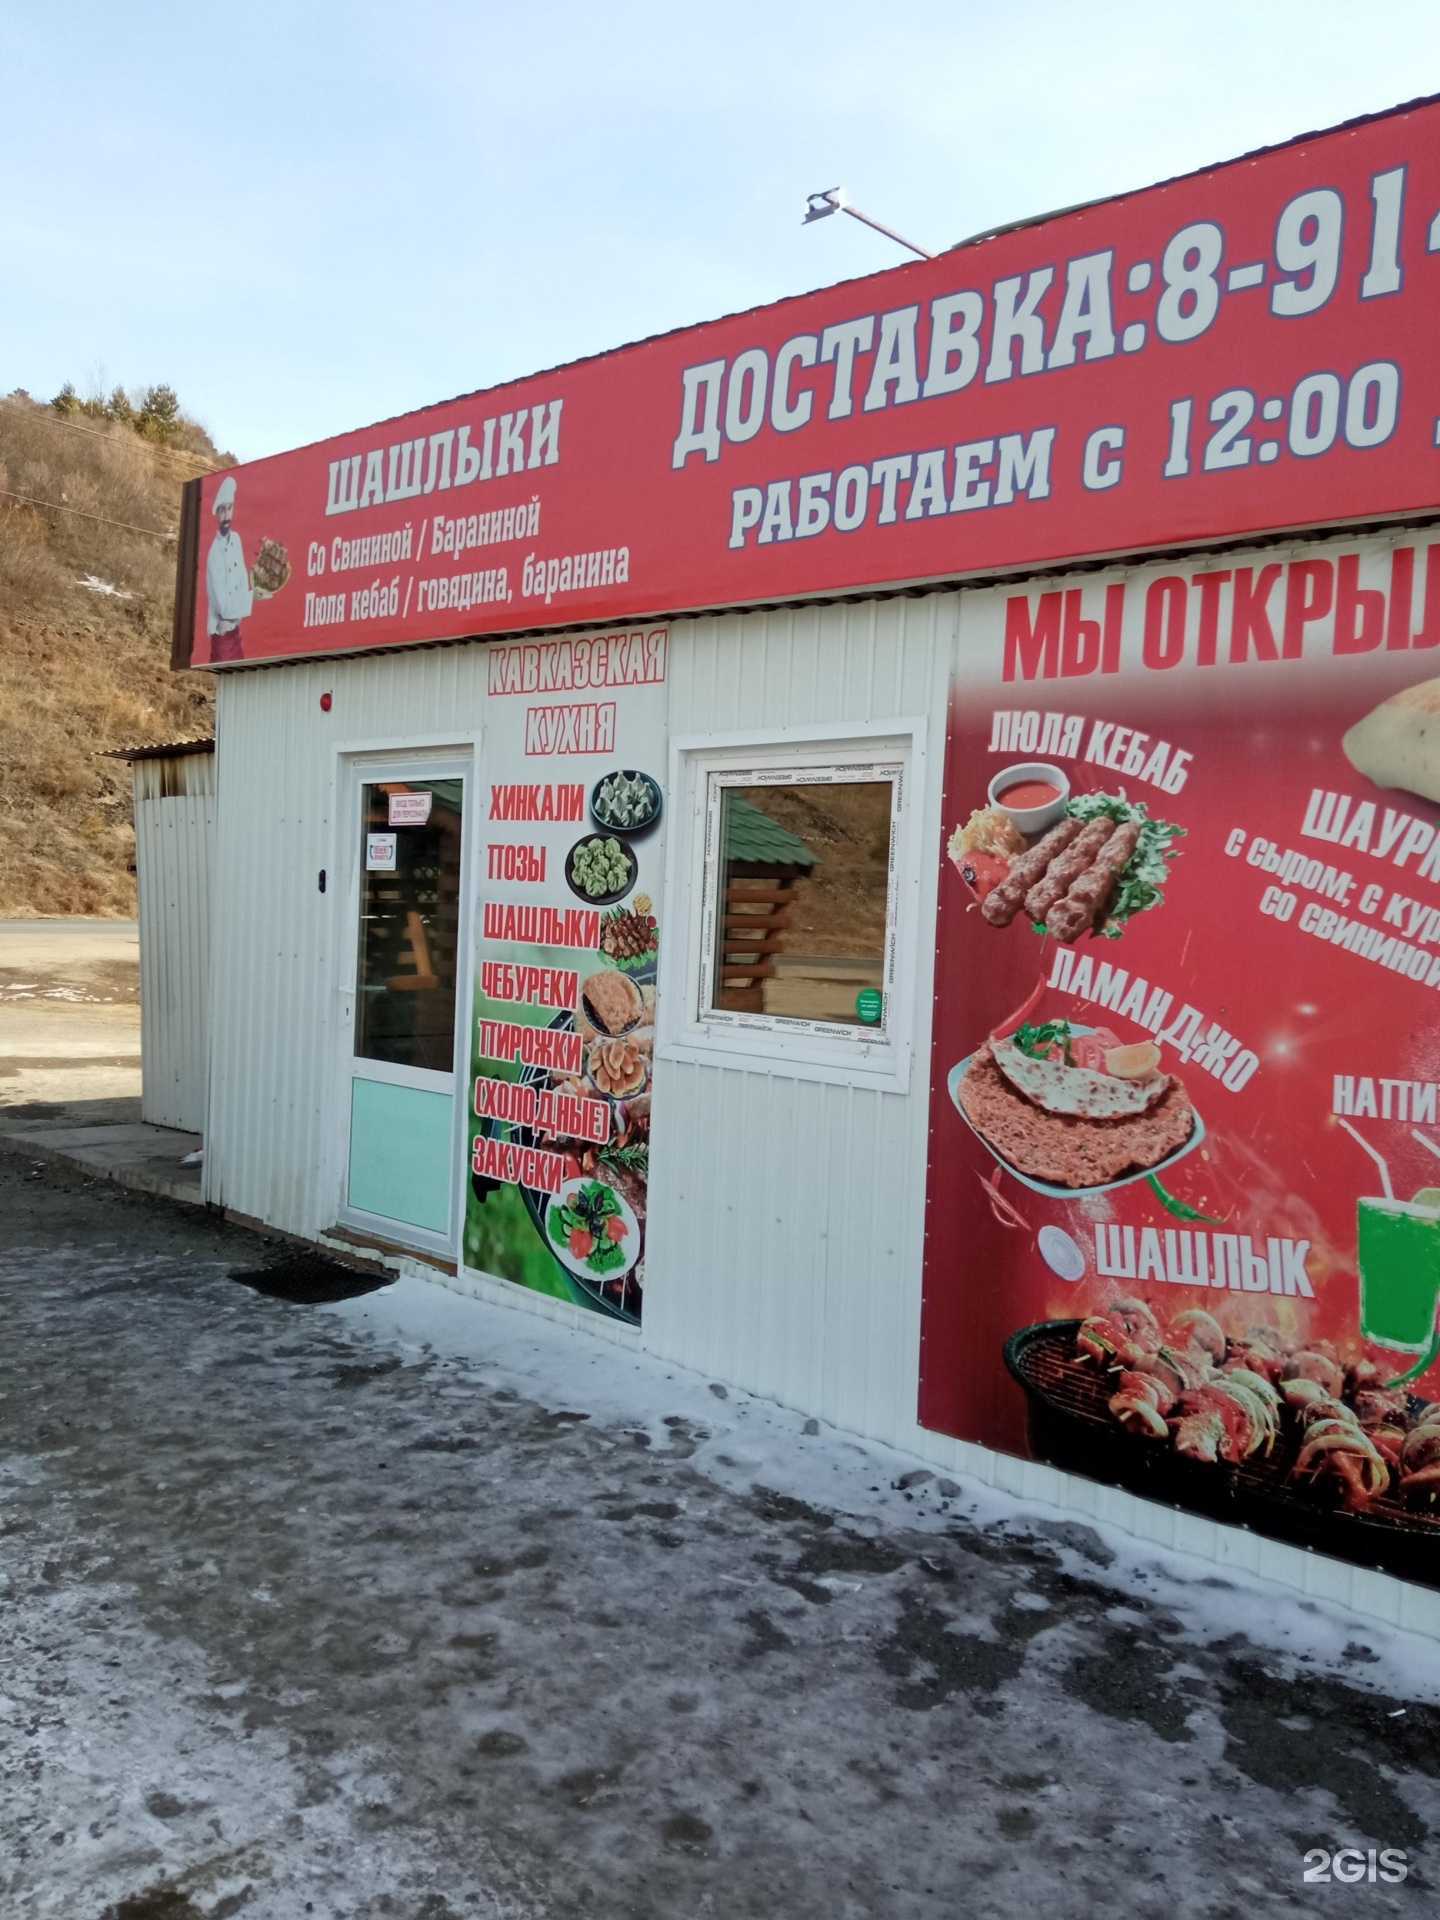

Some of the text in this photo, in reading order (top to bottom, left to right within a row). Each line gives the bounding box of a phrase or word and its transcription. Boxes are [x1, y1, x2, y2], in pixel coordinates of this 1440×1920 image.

[325, 399, 565, 516] ШАШЛЫКИ
[727, 427, 1056, 550] РАБОТАЕМ
[1163, 360, 1402, 479] 12:00
[307, 541, 326, 577] Со
[331, 521, 413, 573] Свининой
[431, 495, 541, 560] Бараниной
[303, 592, 345, 627] Люля
[350, 575, 400, 621] кебаб
[417, 567, 513, 612] говядина,
[521, 546, 630, 604] баранина
[487, 628, 668, 696] КАВКАЗСКАЯ
[1001, 582, 1126, 682] МЫ
[524, 702, 616, 756] КУХНЯ
[987, 710, 1194, 795] ЛЮЛЯ КЕБАБ
[488, 784, 585, 822] ХИНКАЛИ
[487, 844, 547, 882] ПОЗЫ
[483, 903, 600, 950] ШАШЛЫКИ
[480, 960, 580, 1010] ЧЕБУРЕКИ
[478, 1018, 583, 1075] ПИРОЖКИ
[474, 1076, 612, 1144] (ХОЛОДНЫЕ)
[1332, 1074, 1440, 1125] НАПИ
[472, 1136, 564, 1194] ЗАКУСКИ
[1095, 1222, 1316, 1299] ШАШЛЫК
